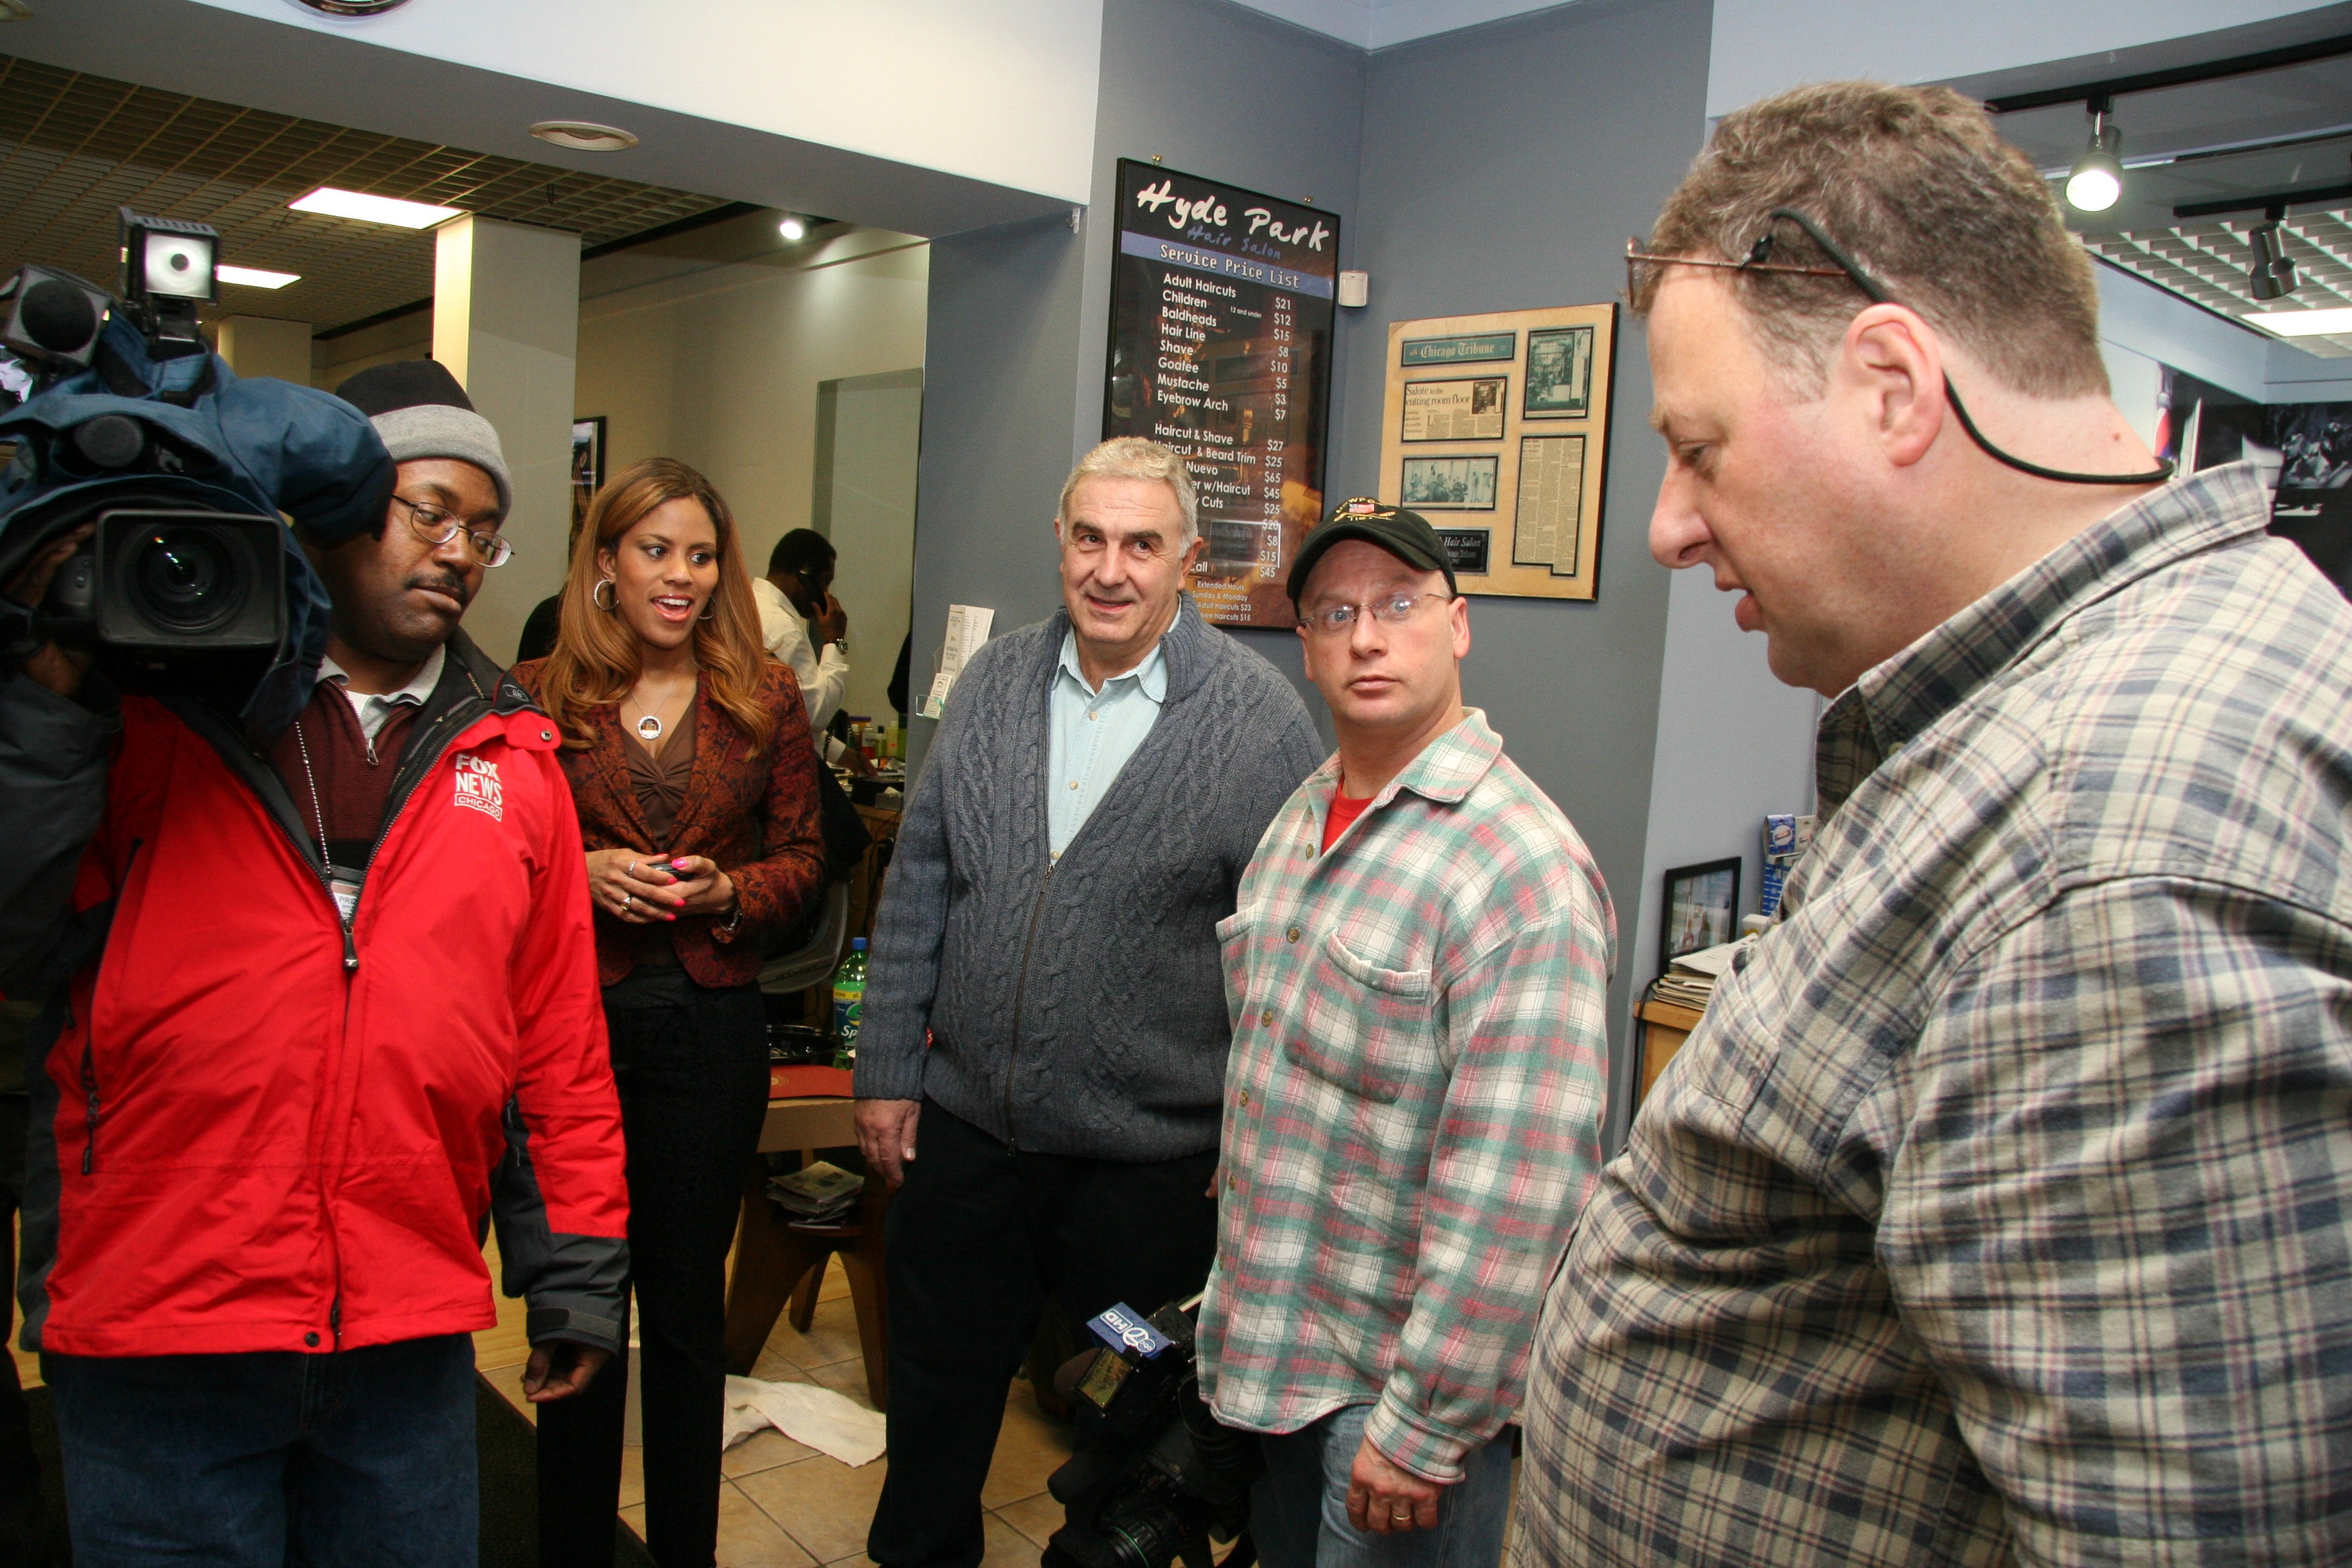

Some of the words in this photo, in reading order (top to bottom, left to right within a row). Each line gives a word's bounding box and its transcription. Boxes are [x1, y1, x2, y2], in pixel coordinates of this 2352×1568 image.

[1137, 180, 1228, 230] Hyde
[1244, 207, 1329, 252] Park
[1187, 226, 1232, 246] Hair
[1160, 244, 1217, 270] Service
[1226, 259, 1263, 279] Price
[1270, 271, 1300, 289] List
[1163, 273, 1192, 289] Adult
[1195, 279, 1236, 298] Haircuts
[1275, 297, 1291, 310] $21
[1163, 289, 1207, 309] Children
[1274, 313, 1291, 326] $12
[1162, 306, 1217, 328] Baldheads
[1273, 328, 1289, 342] $15
[1161, 323, 1183, 336] Hair
[1185, 325, 1206, 342] Line
[1278, 345, 1289, 358] $8
[1421, 345, 1455, 358] Chicago
[1458, 342, 1494, 356] Tribune
[1160, 340, 1194, 356] Shave
[1271, 360, 1288, 373] $10
[1158, 357, 1199, 373] Goatee
[1276, 377, 1287, 389] $5
[1157, 373, 1210, 392] Mustache
[1275, 393, 1286, 405] $3
[1406, 385, 1428, 395] Salute
[1157, 390, 1201, 407] Eyebrow
[1204, 397, 1228, 411] Arch
[1275, 408, 1286, 421] $7
[1406, 397, 1430, 406] cutting
[1453, 394, 1471, 404] floor
[1155, 423, 1192, 438] Haircut
[1194, 430, 1200, 440] &
[1203, 430, 1234, 445] Shave
[1267, 439, 1284, 452] $27
[1197, 446, 1203, 457] &
[1206, 447, 1234, 461] Beard
[1236, 451, 1256, 464] Trim
[1265, 456, 1283, 468] $25
[1186, 460, 1218, 475] Nuevo
[1265, 471, 1281, 483] $65
[1192, 481, 1201, 489] er
[1204, 481, 1251, 495] w/Haircut
[1264, 487, 1280, 499] $45
[1202, 496, 1223, 508] Cuts
[1264, 503, 1280, 515] $25
[1262, 519, 1279, 531] $20
[1267, 535, 1278, 547] $8
[1444, 537, 1460, 546] Hair
[1461, 537, 1481, 547] Salon
[1260, 550, 1276, 562] $15
[1259, 567, 1275, 578] $45
[1197, 581, 1226, 589] Extended
[1192, 591, 1215, 599] Sunday
[1223, 593, 1248, 602] Monday
[1216, 603, 1239, 611] Haircuts
[1240, 614, 1251, 622] $15
[456, 753, 501, 783] FOX
[455, 772, 503, 805] NEWS
[458, 796, 499, 817] CHICAGO
[841, 1025, 858, 1038] Sp
[1105, 1312, 1128, 1330] HD
